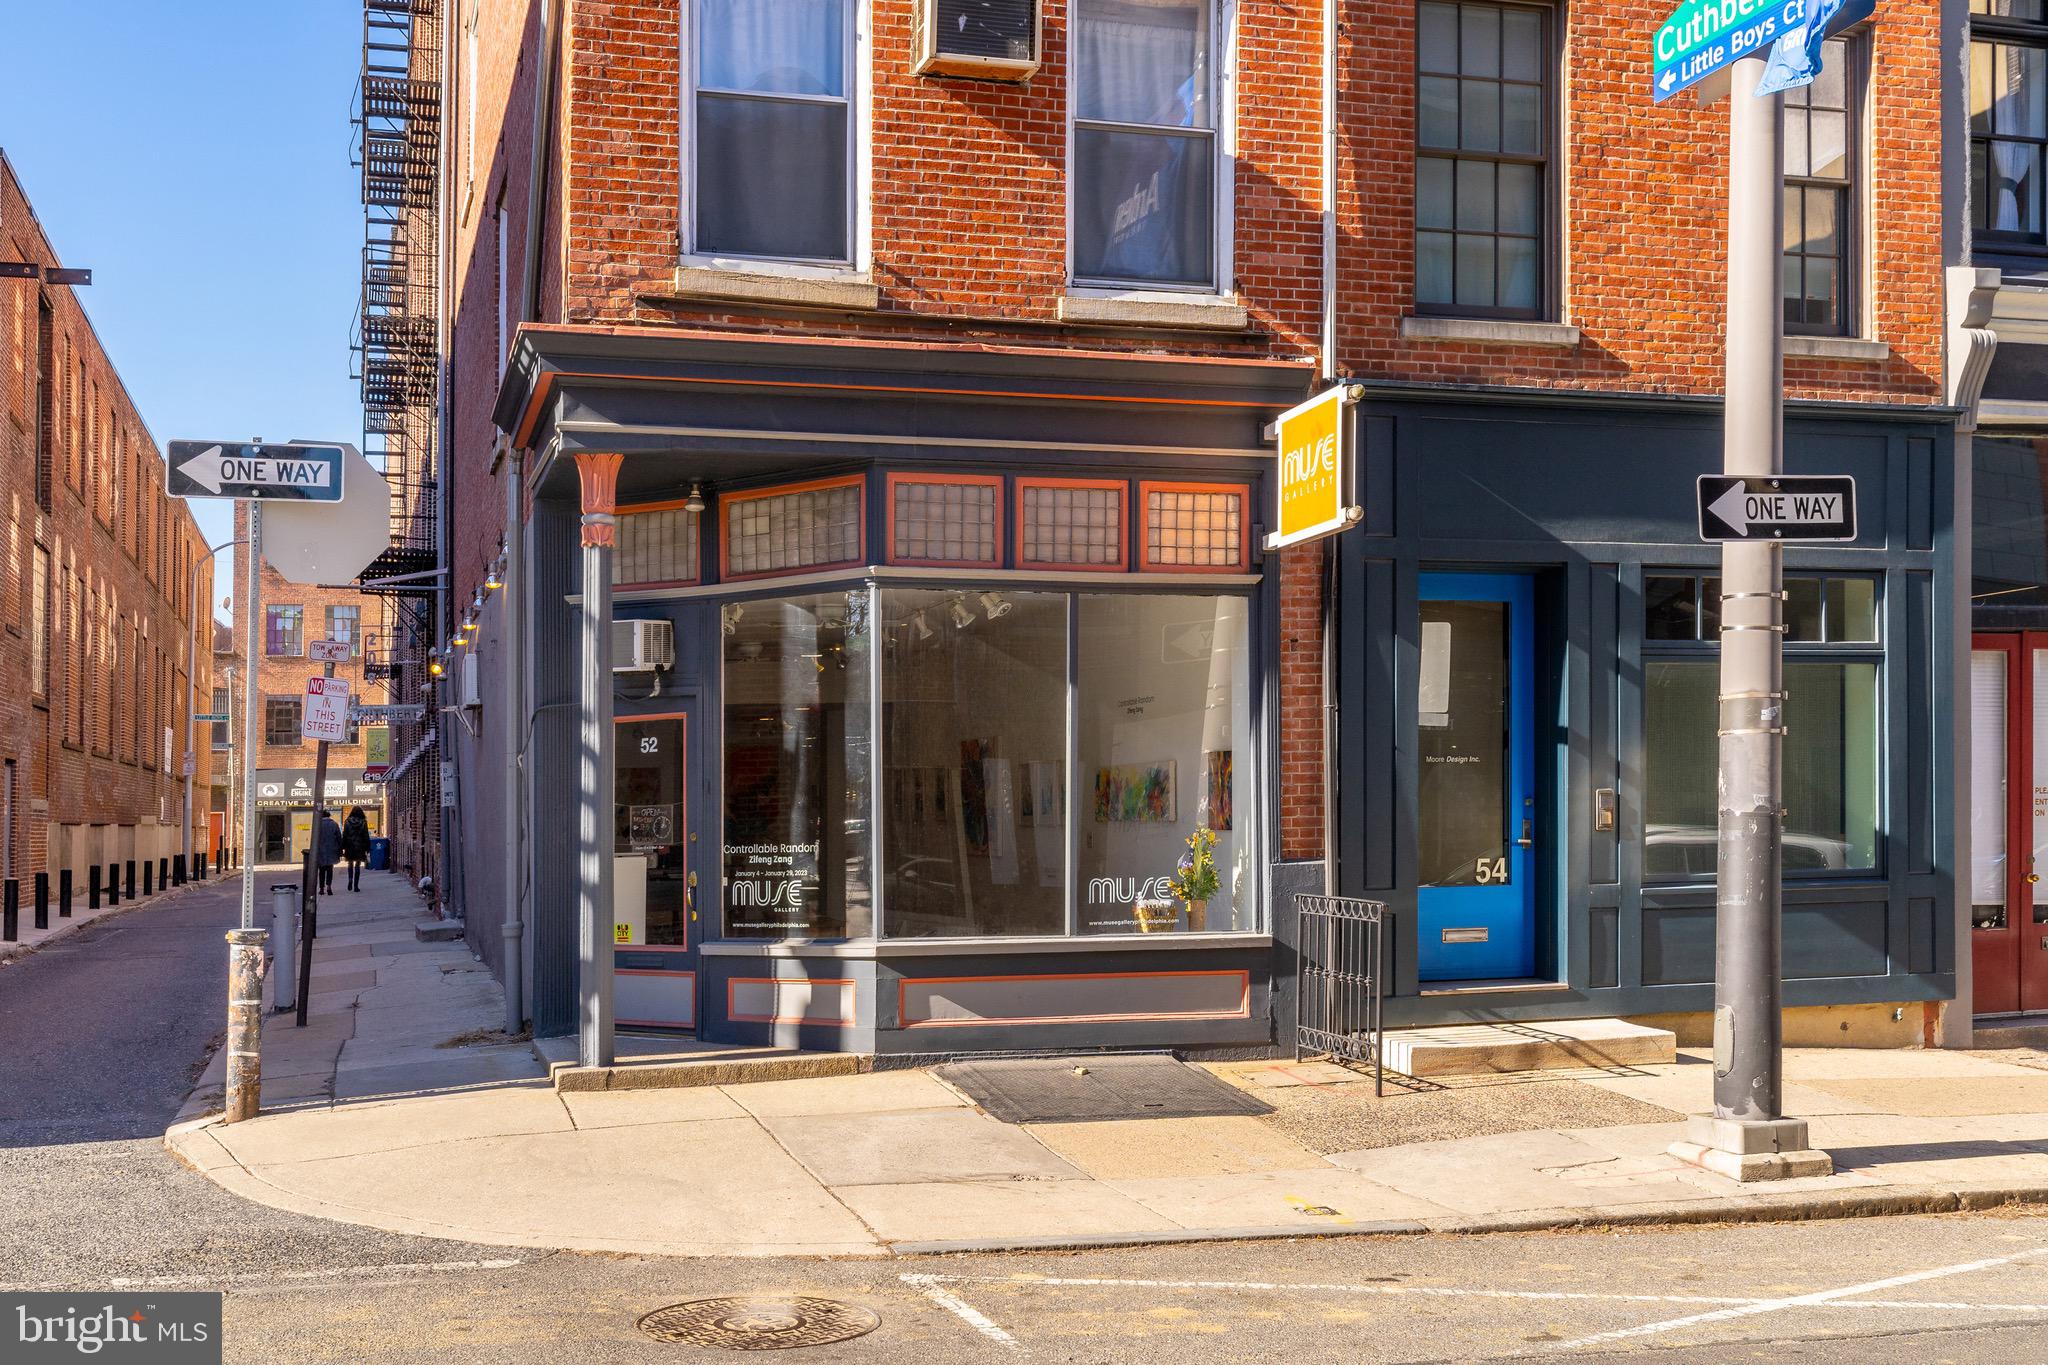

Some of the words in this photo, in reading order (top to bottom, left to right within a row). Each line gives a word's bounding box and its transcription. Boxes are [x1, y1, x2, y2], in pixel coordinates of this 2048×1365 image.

[1681, 48, 1723, 83] Little
[1731, 16, 1775, 55] Boys
[1783, 0, 1804, 24] Ct
[1284, 433, 1334, 487] MUSE
[221, 459, 267, 481] ONE
[276, 461, 324, 484] WAY
[1284, 475, 1333, 502] GALLERY
[1746, 496, 1786, 520] ONE
[1794, 496, 1836, 520] WAY
[313, 643, 326, 652] TOW
[331, 645, 348, 654] AWAY
[321, 652, 338, 660] ZONE
[310, 679, 323, 694] NO
[325, 682, 347, 694] PARKING
[322, 699, 332, 709] IN
[315, 709, 336, 721] THIS
[306, 720, 341, 734] STREET
[640, 736, 658, 754] 52
[364, 772, 381, 781] 219
[290, 789, 312, 797] ENGINE
[333, 798, 373, 806] BUILDING
[724, 843, 778, 854] Controllable
[780, 842, 819, 853] Random
[749, 855, 772, 866] Zifeng
[773, 855, 793, 866] Zang
[735, 870, 755, 878] January
[765, 870, 785, 878] January
[1476, 858, 1507, 883] 54
[733, 879, 802, 907] MUSE
